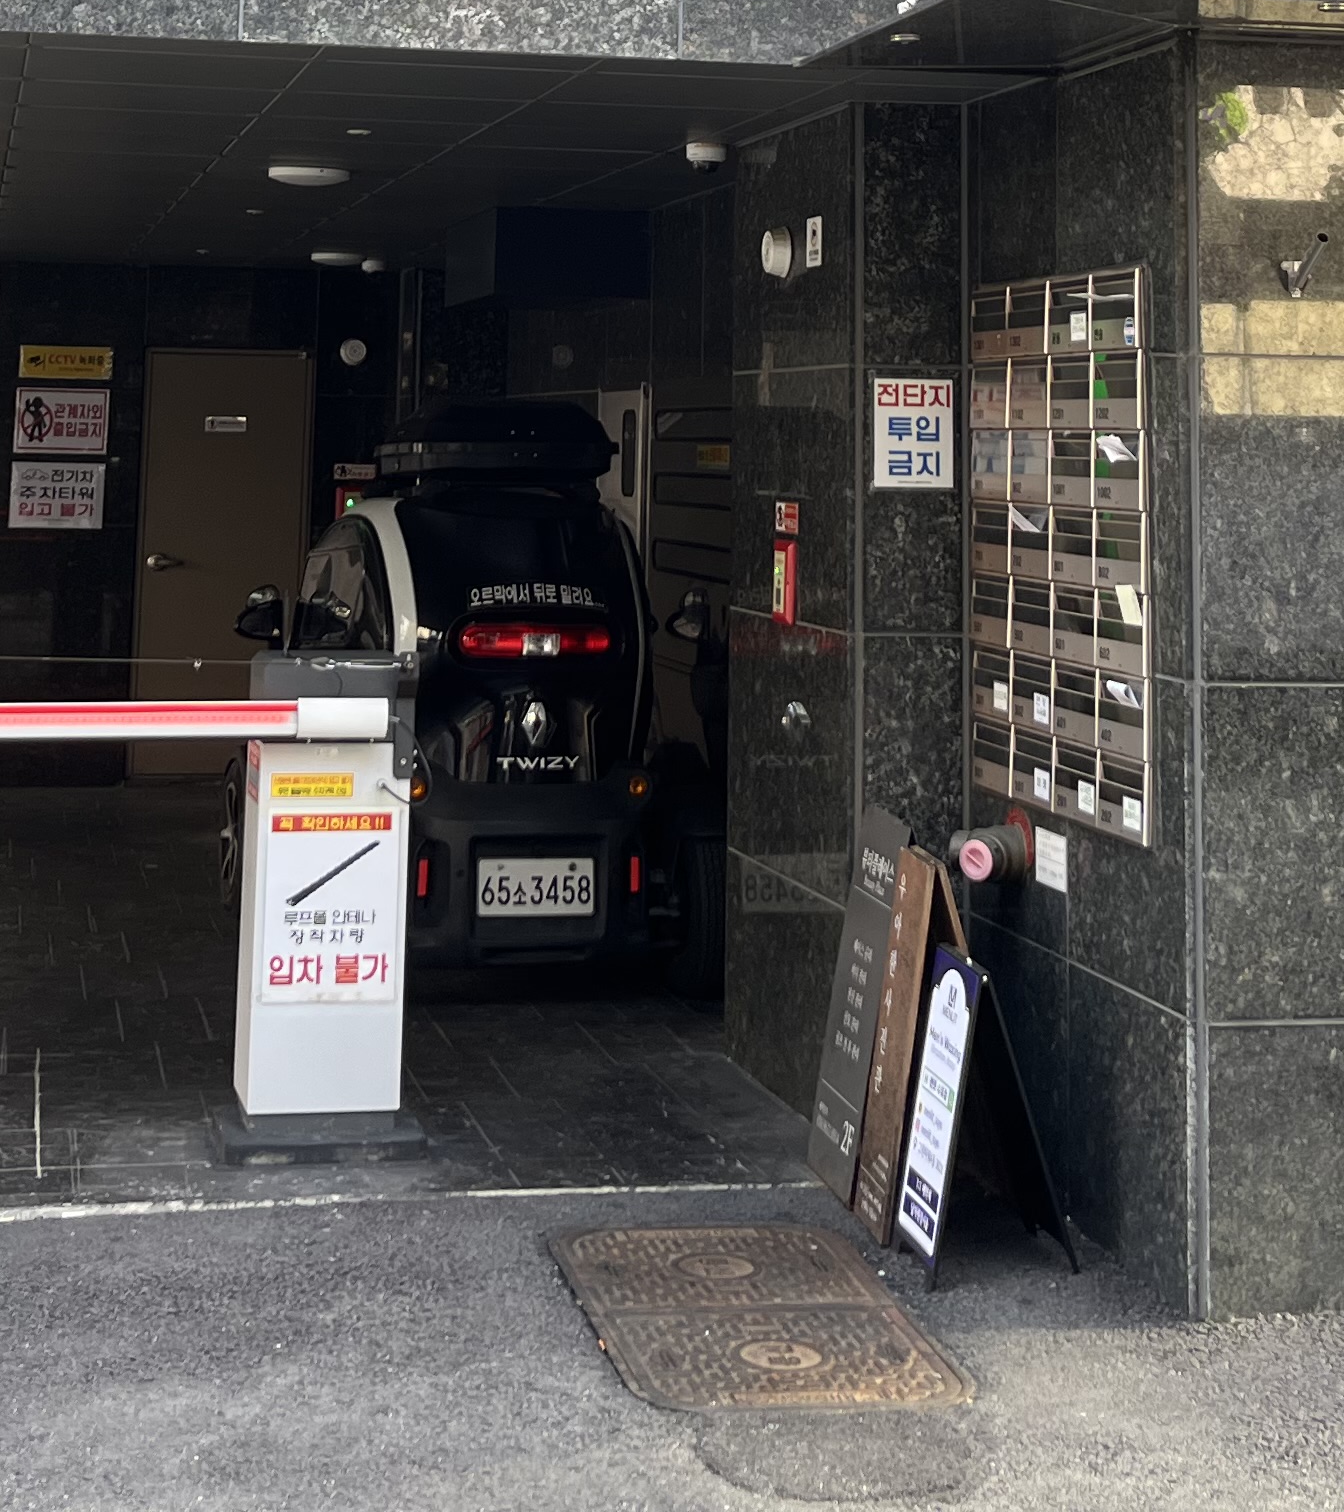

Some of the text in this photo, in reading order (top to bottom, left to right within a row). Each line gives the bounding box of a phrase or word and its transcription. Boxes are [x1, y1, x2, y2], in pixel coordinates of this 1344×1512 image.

[48, 353, 77, 365] CCTV
[877, 383, 951, 408] 전단지
[53, 403, 104, 420] 관계자외
[52, 422, 103, 438] 출입금지
[888, 416, 940, 442] 투입
[888, 450, 940, 477] 금지
[51, 469, 95, 484] 전기차
[470, 583, 530, 606] 오르막에서
[533, 583, 557, 604] 뒤로
[496, 755, 581, 771] TWIZY
[481, 874, 592, 907] 65소3458
[332, 909, 376, 925] 안테나
[269, 953, 389, 986] 입차 불가
[840, 1120, 855, 1156] 2F
